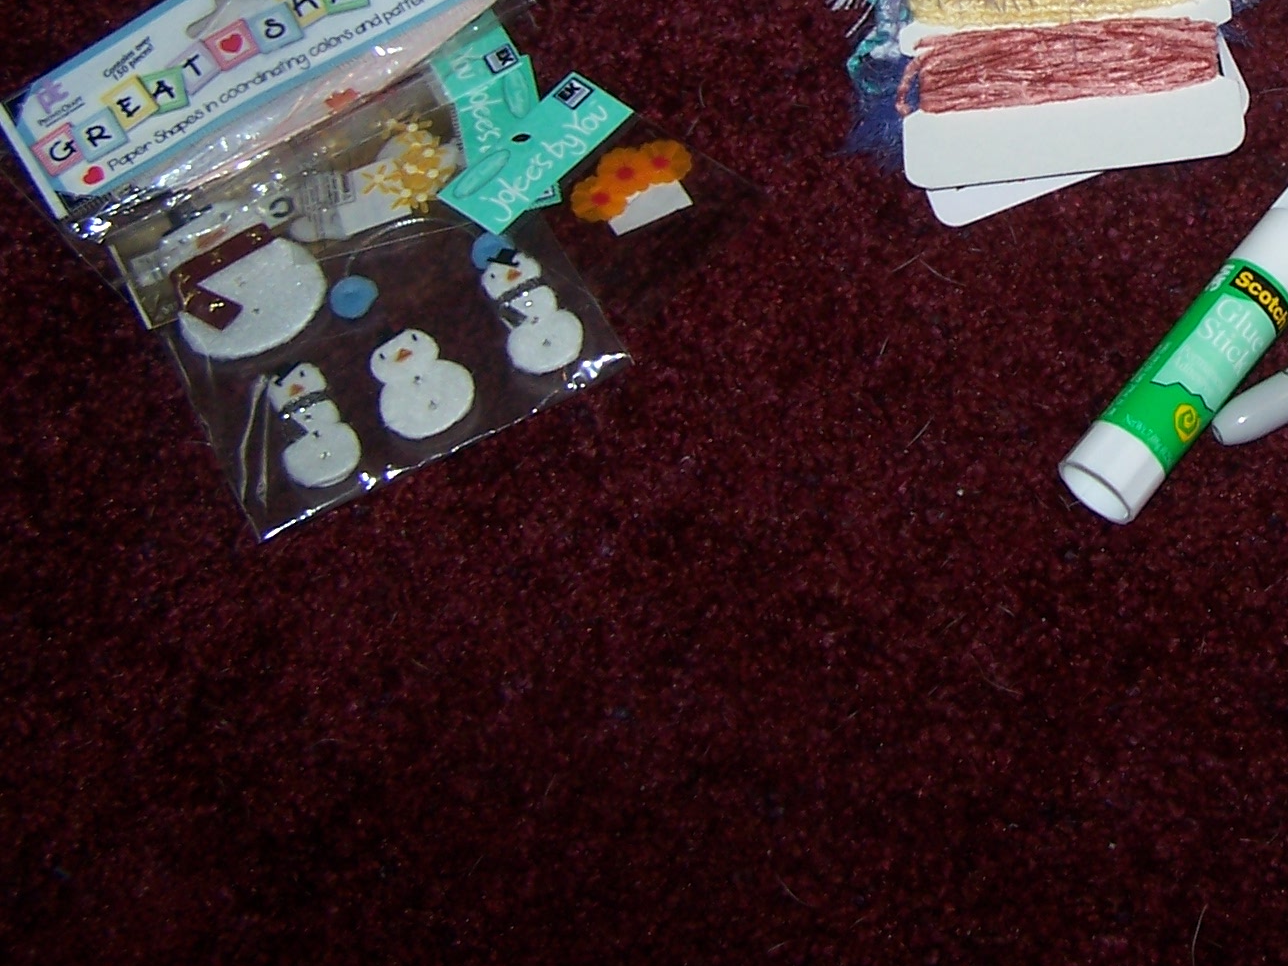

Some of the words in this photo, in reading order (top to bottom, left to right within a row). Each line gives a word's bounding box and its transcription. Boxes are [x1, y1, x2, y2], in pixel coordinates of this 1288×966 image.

[106, 141, 151, 172] Paper
[153, 108, 205, 144] Shapes
[206, 98, 219, 113] in
[219, 53, 312, 105] coordinating
[309, 28, 354, 57] colors
[354, 14, 385, 35] and
[541, 134, 588, 160] by
[1199, 317, 1250, 377] Stick
[1216, 297, 1265, 352] Glue
